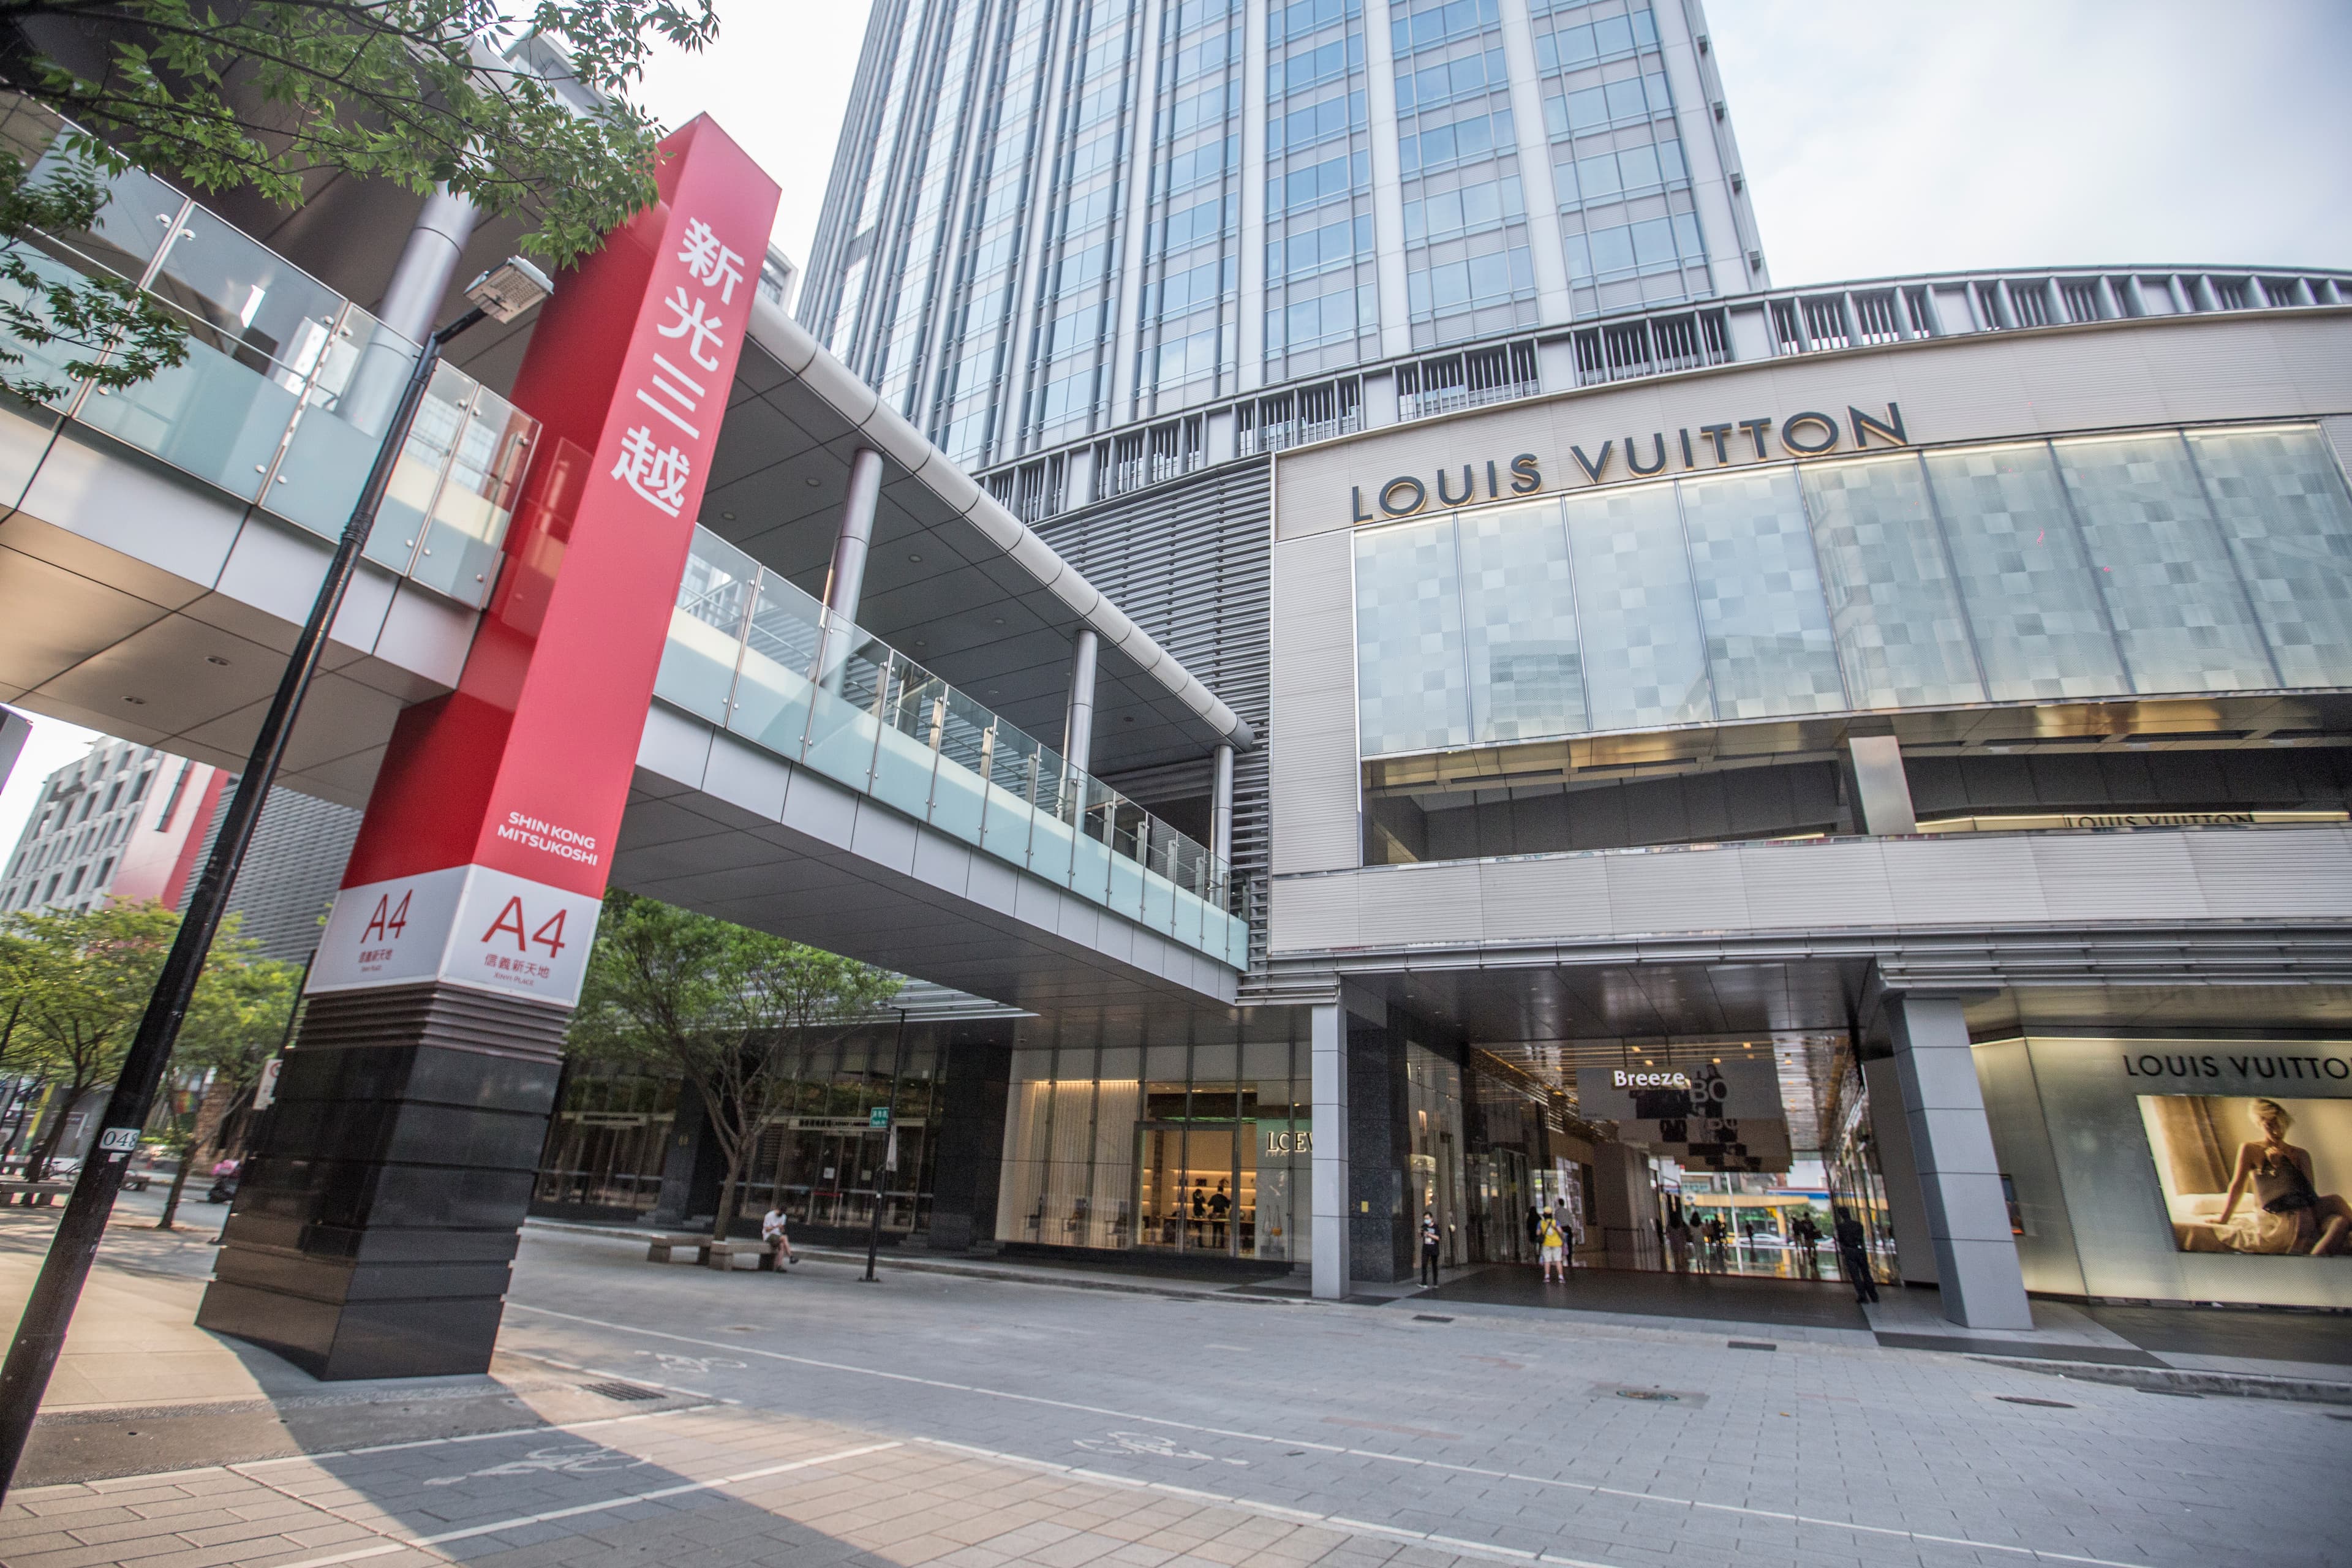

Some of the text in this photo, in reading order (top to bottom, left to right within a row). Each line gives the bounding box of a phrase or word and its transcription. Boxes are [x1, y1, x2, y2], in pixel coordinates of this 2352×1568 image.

[611, 217, 745, 518] 新光三越
[1352, 402, 1907, 526] LOUIS VUITTON
[497, 824, 598, 866] MITSUKOSHI
[508, 812, 596, 850] SHIN KONG
[360, 889, 413, 943] A4
[481, 895, 567, 959] A4
[484, 953, 550, 979] 信義新天地
[1613, 1070, 1685, 1087] Breeze
[2123, 1055, 2352, 1080] LOUIS VUITTO
